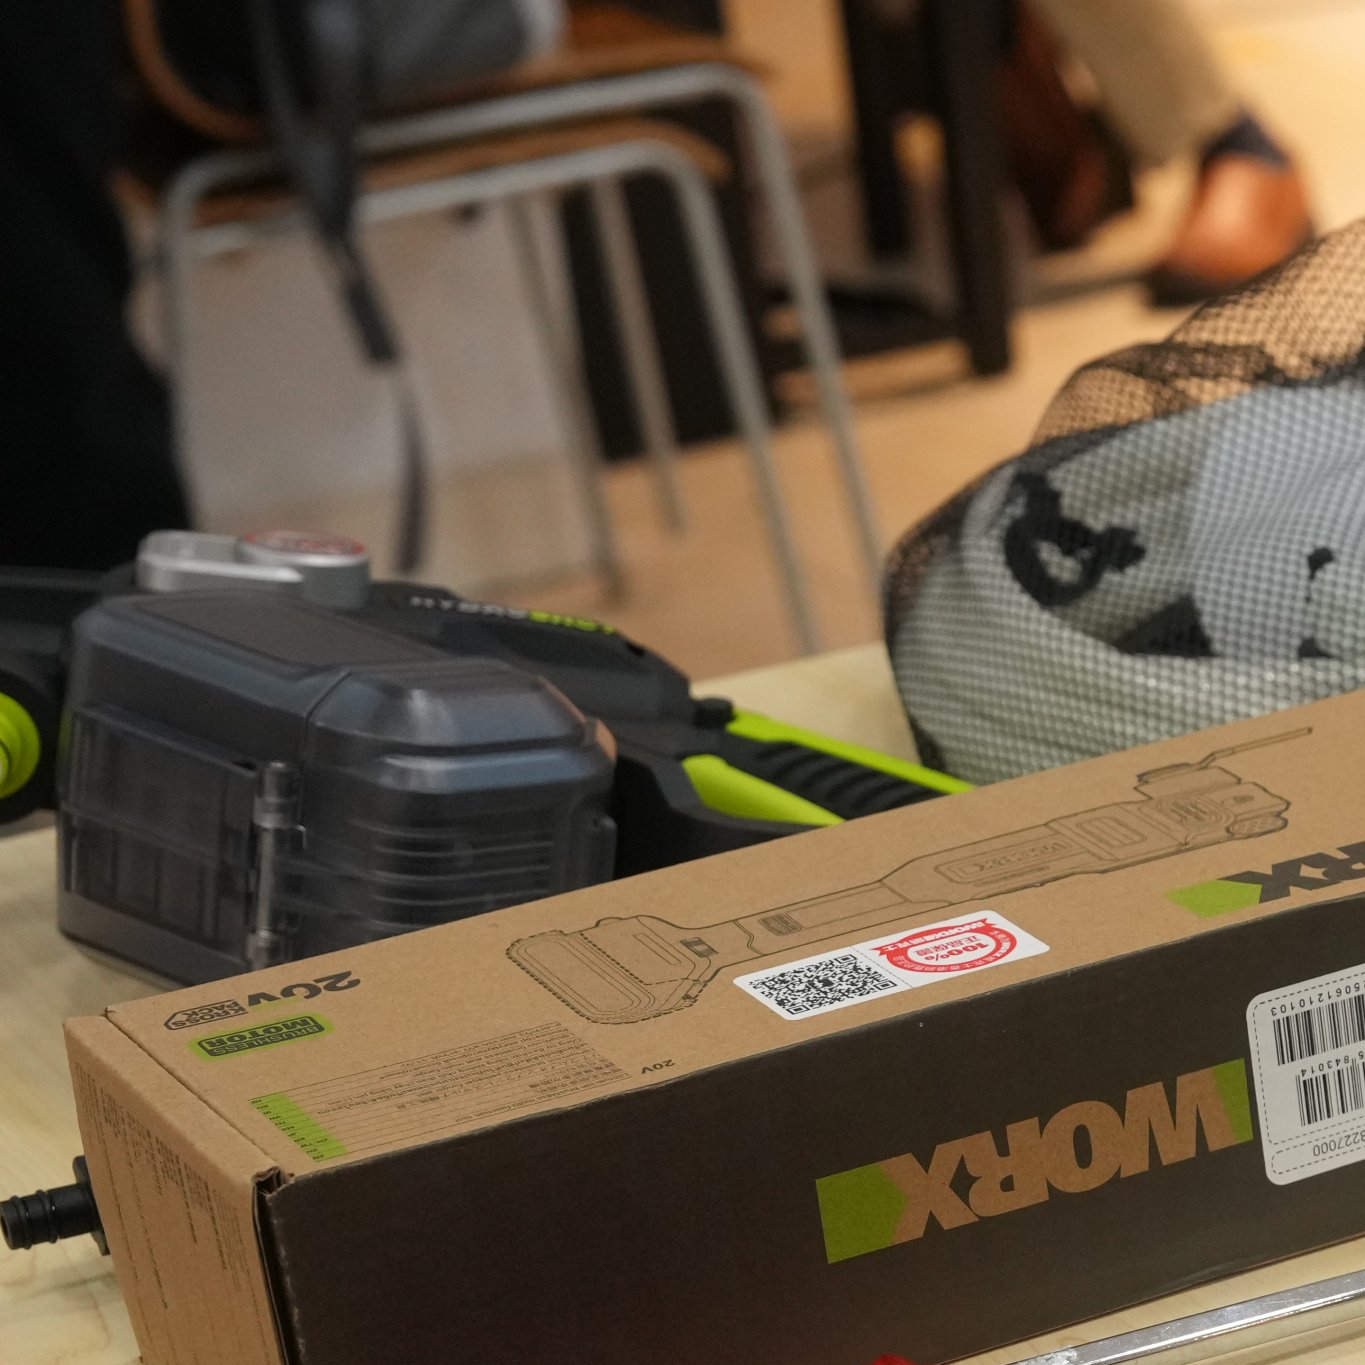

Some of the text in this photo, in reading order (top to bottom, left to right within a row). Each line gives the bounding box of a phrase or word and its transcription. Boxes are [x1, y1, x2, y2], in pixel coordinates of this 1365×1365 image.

[925, 942, 989, 962] 100%
[172, 1005, 249, 1028] KROSS
[183, 1000, 245, 1018] PACK
[206, 1018, 313, 1049] MOTOR
[213, 1025, 322, 1056] BRUSHLESS
[641, 1058, 676, 1075] 20V
[1301, 1055, 1350, 1077] 843014
[888, 1063, 1240, 1246] WORX
